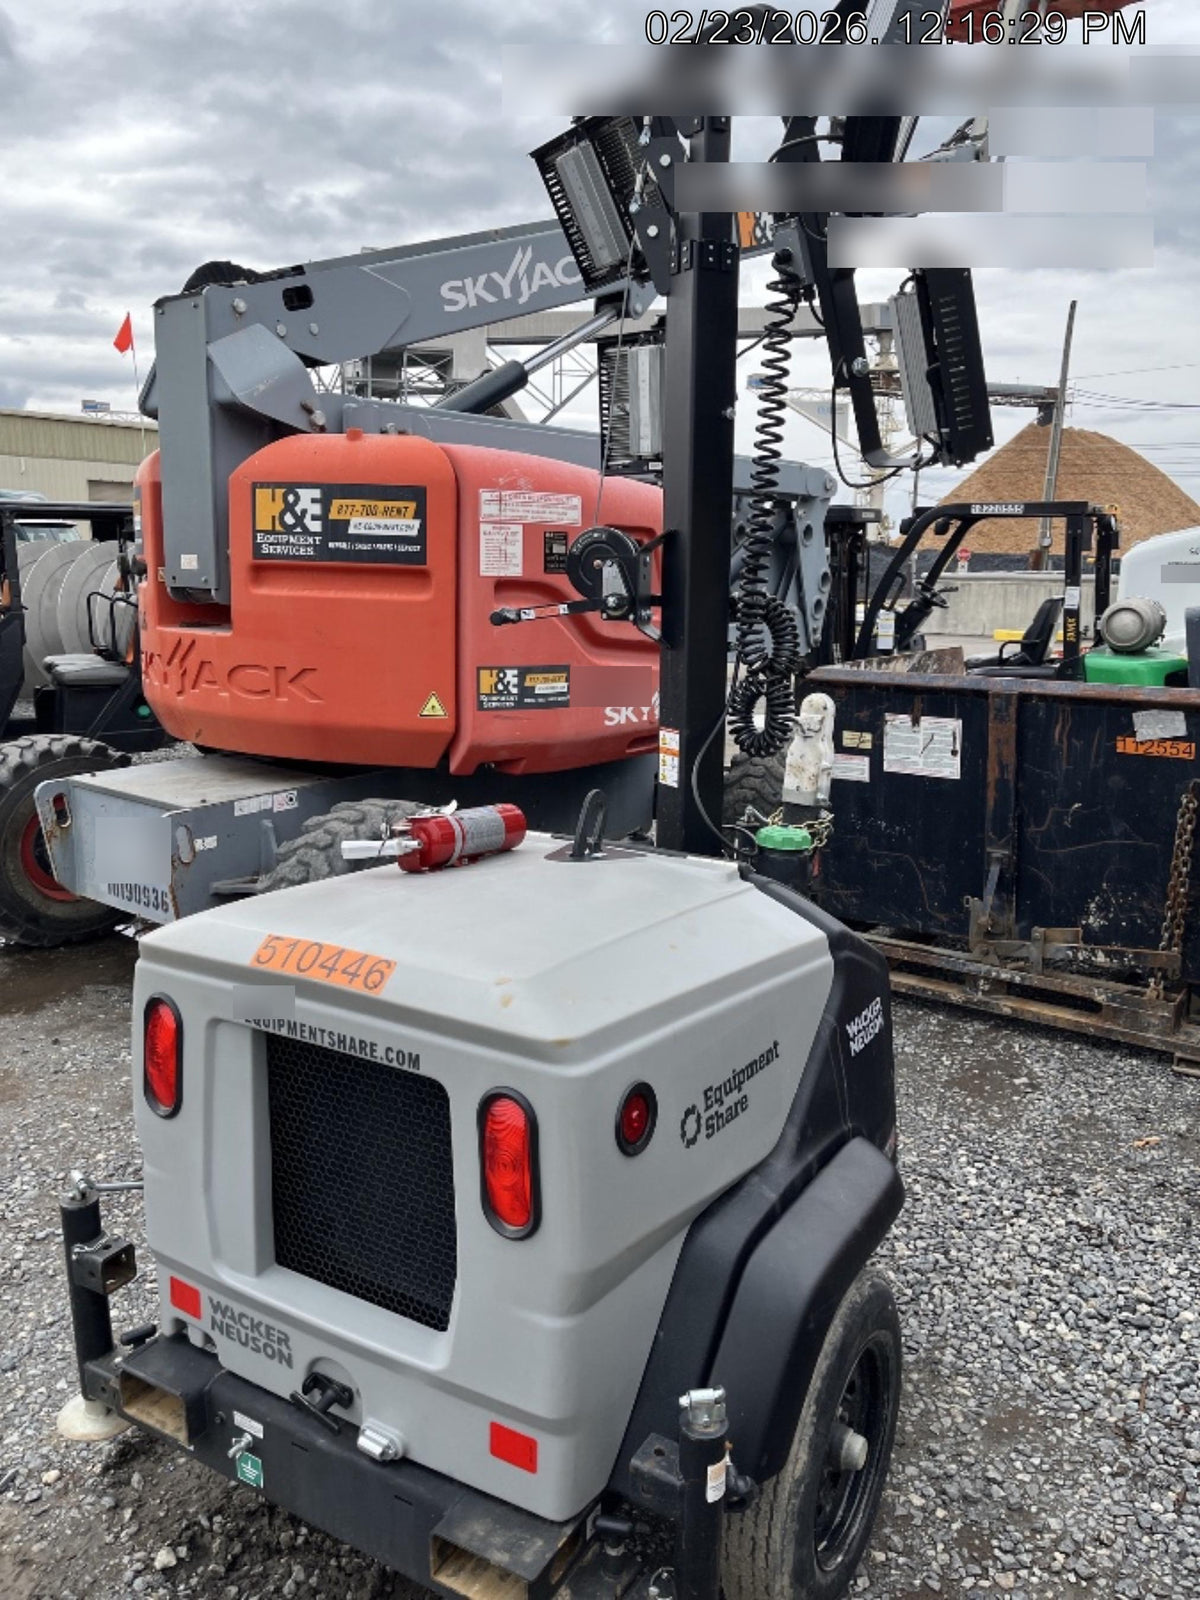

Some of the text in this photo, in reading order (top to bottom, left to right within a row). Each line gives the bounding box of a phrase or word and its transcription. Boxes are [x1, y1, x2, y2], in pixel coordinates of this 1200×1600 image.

[255, 488, 322, 532] H&E
[256, 533, 322, 545] EQUIPMENT
[261, 544, 314, 556] SERVICES
[480, 669, 518, 694] H&E
[255, 936, 393, 991] 510446
[846, 997, 882, 1036] WACKER
[850, 1013, 884, 1057] NEUSON
[704, 1040, 779, 1113] Equipment
[705, 1094, 749, 1140] Share
[208, 1295, 292, 1351] WACKER
[211, 1315, 294, 1370] NEUSON
